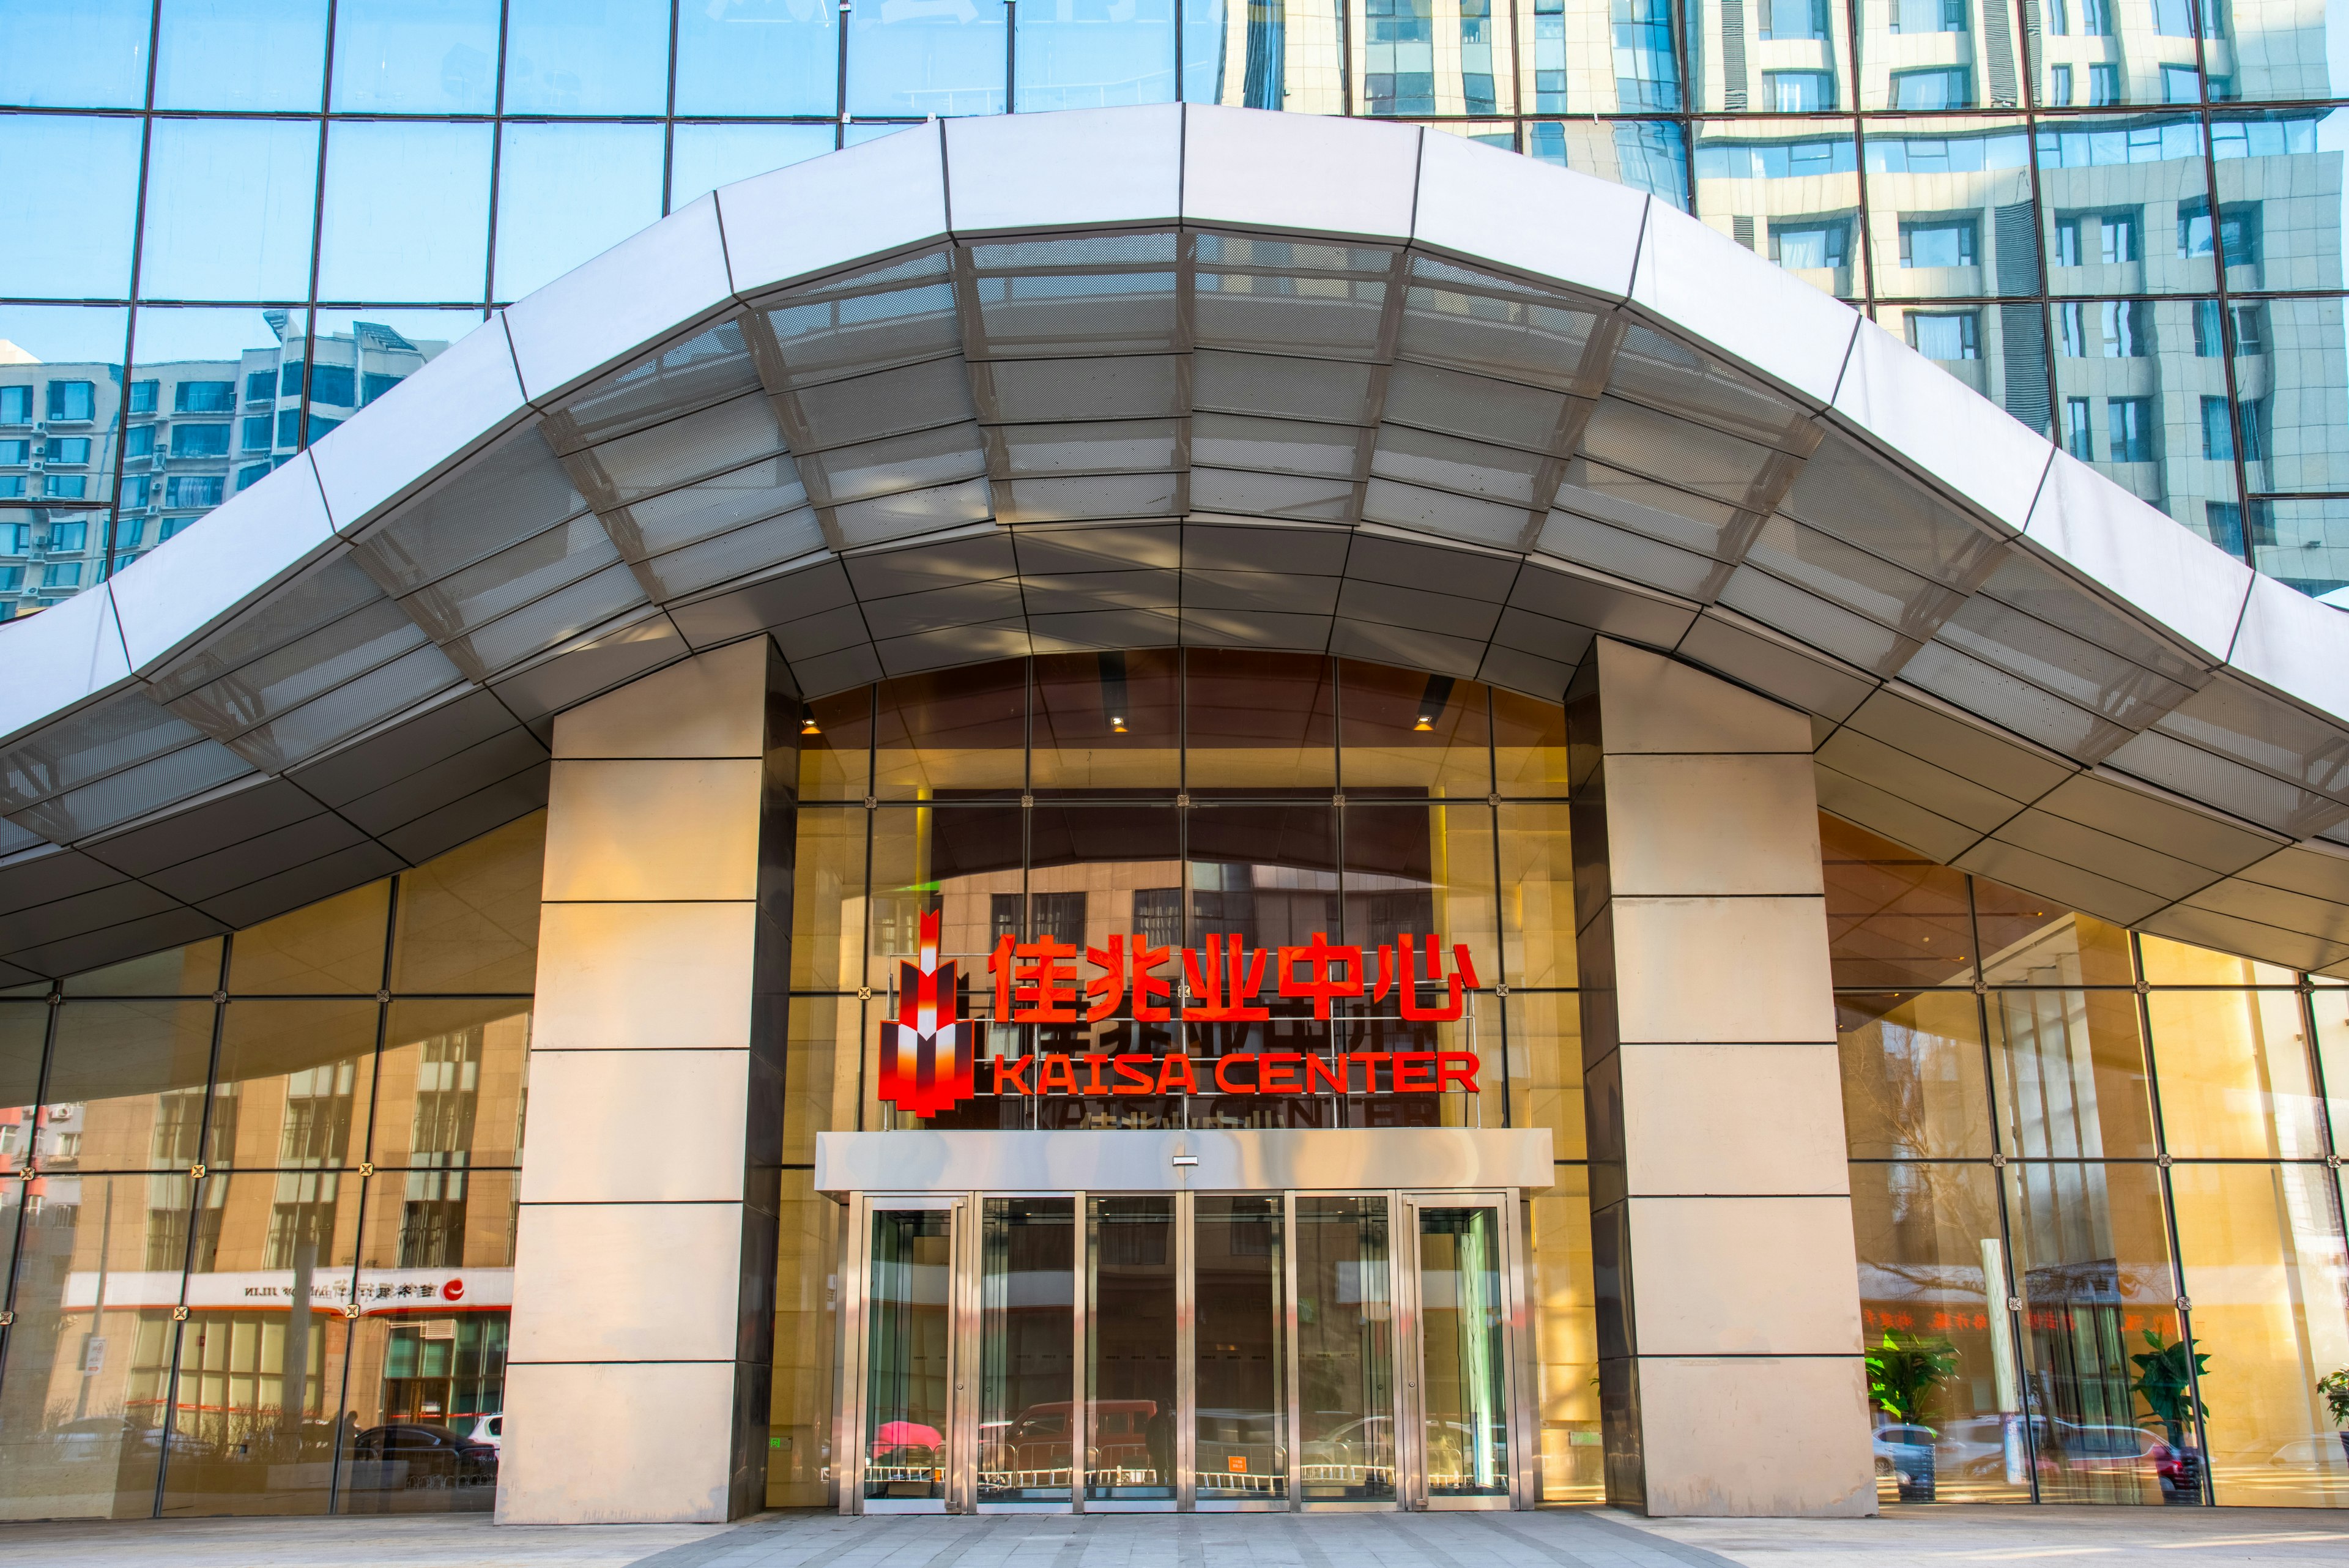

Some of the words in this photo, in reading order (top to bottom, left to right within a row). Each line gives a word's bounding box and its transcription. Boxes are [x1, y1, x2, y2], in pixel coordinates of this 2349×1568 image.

[987, 932, 1481, 1023] 佳兆业中心
[992, 1054, 1198, 1095] KAISA
[1214, 1052, 1481, 1094] CENTER
